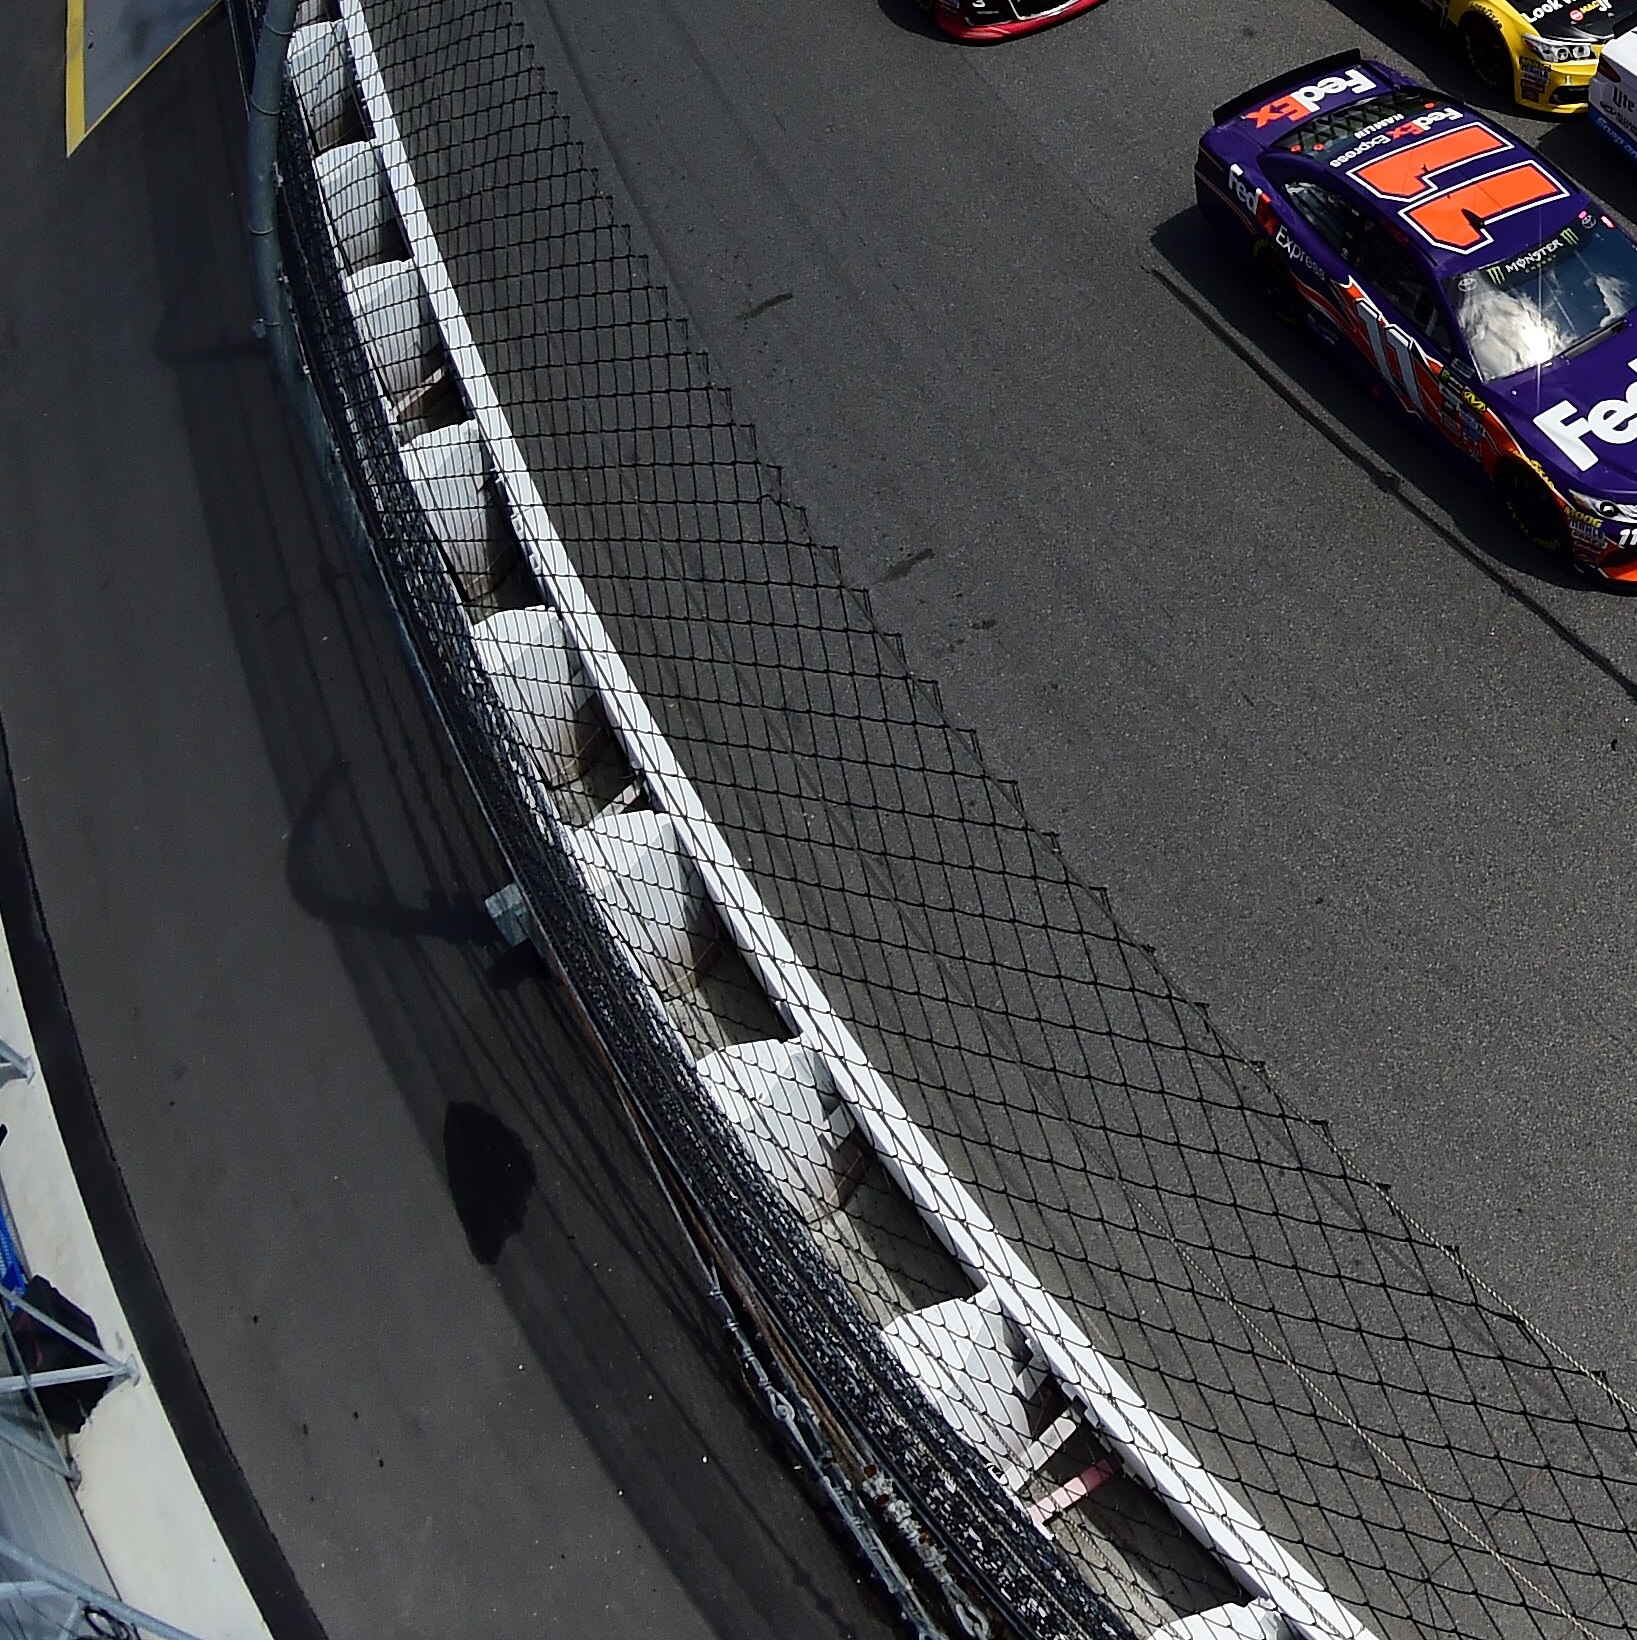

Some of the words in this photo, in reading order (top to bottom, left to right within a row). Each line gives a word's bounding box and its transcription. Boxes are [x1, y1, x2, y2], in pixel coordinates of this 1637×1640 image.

[1243, 68, 1377, 129] FedEx
[1611, 86, 1636, 113] Lite
[1353, 112, 1405, 140] HAMLIN
[1386, 107, 1465, 141] FedEx
[1329, 133, 1393, 169] Express
[1347, 121, 1570, 255] 11
[1274, 223, 1327, 282] Express
[1504, 237, 1565, 275] MONSTER
[1354, 296, 1425, 416] 11
